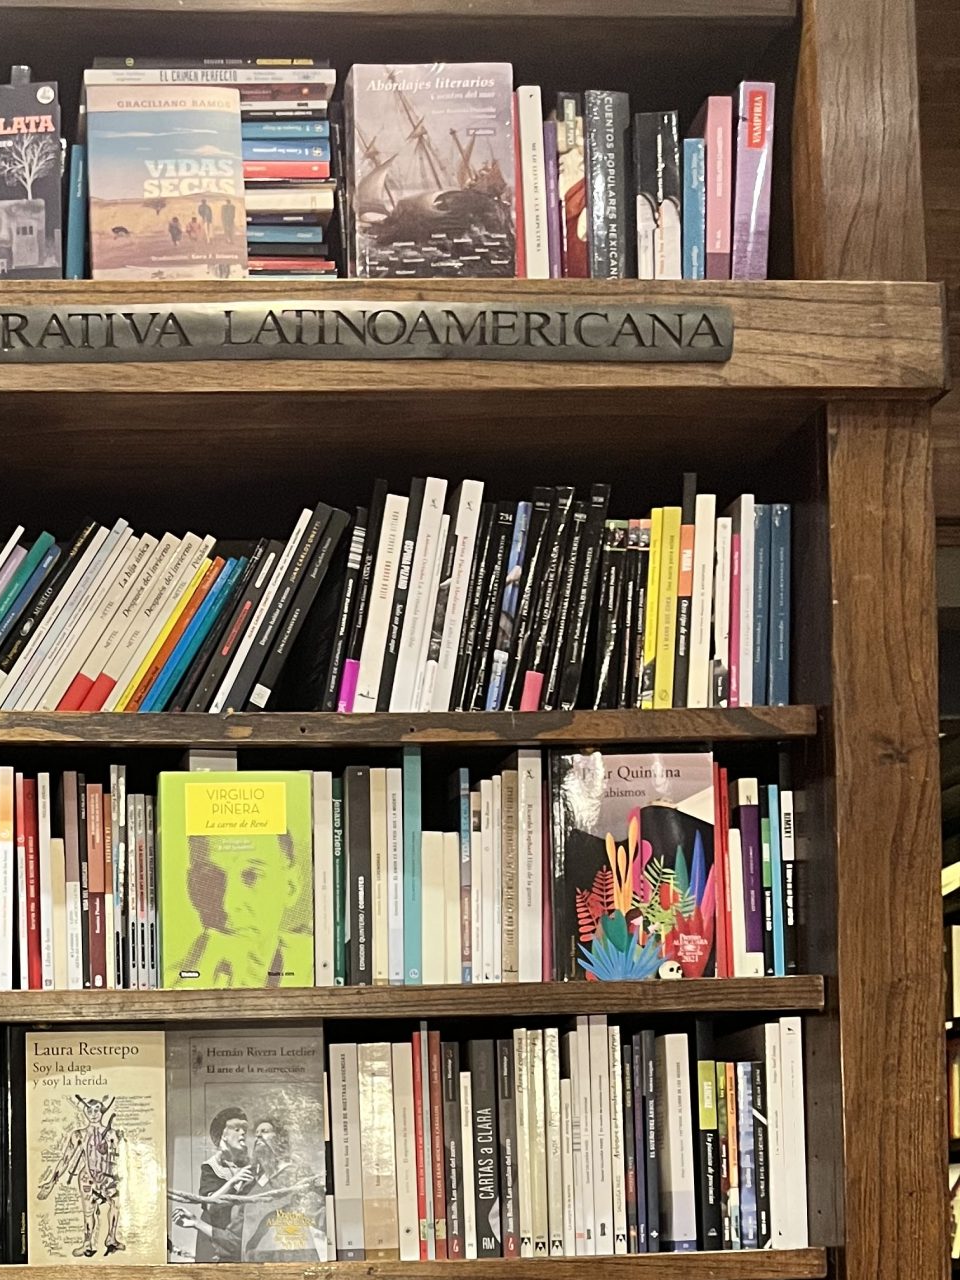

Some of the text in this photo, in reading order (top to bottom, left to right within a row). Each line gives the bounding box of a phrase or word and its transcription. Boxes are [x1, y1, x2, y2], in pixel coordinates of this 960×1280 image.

[160, 70, 238, 82] EL CRIMEN PERFECTO
[367, 77, 495, 94] Abordajes literarios
[117, 100, 231, 109] GRACILIANO RAMOS
[604, 96, 615, 150] CUENTOS
[144, 159, 234, 178] VIDAS
[143, 178, 237, 198] SECAS
[606, 152, 617, 221] POPULARES
[222, 309, 724, 349] LATINOAMERICANA
[117, 542, 151, 588] La hija única
[289, 566, 300, 582] JUAN
[296, 542, 311, 566] CARLOS
[122, 542, 172, 618] Después del invierno
[617, 766, 681, 782] Quinna
[206, 788, 265, 801] VIRGILIO
[604, 787, 646, 798] abismos
[212, 801, 261, 815] PIÑERA
[205, 819, 268, 829] La carne de René
[332, 799, 343, 856] Jenaro Prieto
[783, 812, 792, 839] RIMSKY
[358, 914, 366, 943] QUINTERO
[33, 1041, 139, 1059] Laura Restrepo
[206, 1046, 316, 1057] Hernán Rivera Letelier
[33, 1062, 92, 1074] Soy la daga
[206, 1064, 306, 1074] El arte de la resurrección
[33, 1075, 108, 1089] y soy la herida
[476, 1108, 492, 1142] CLARA
[449, 1157, 457, 1167] del
[449, 1169, 457, 1189] mañas
[478, 1159, 495, 1200] CARTAS
[449, 1191, 457, 1201] Las
[450, 1218, 458, 1235] Juan
